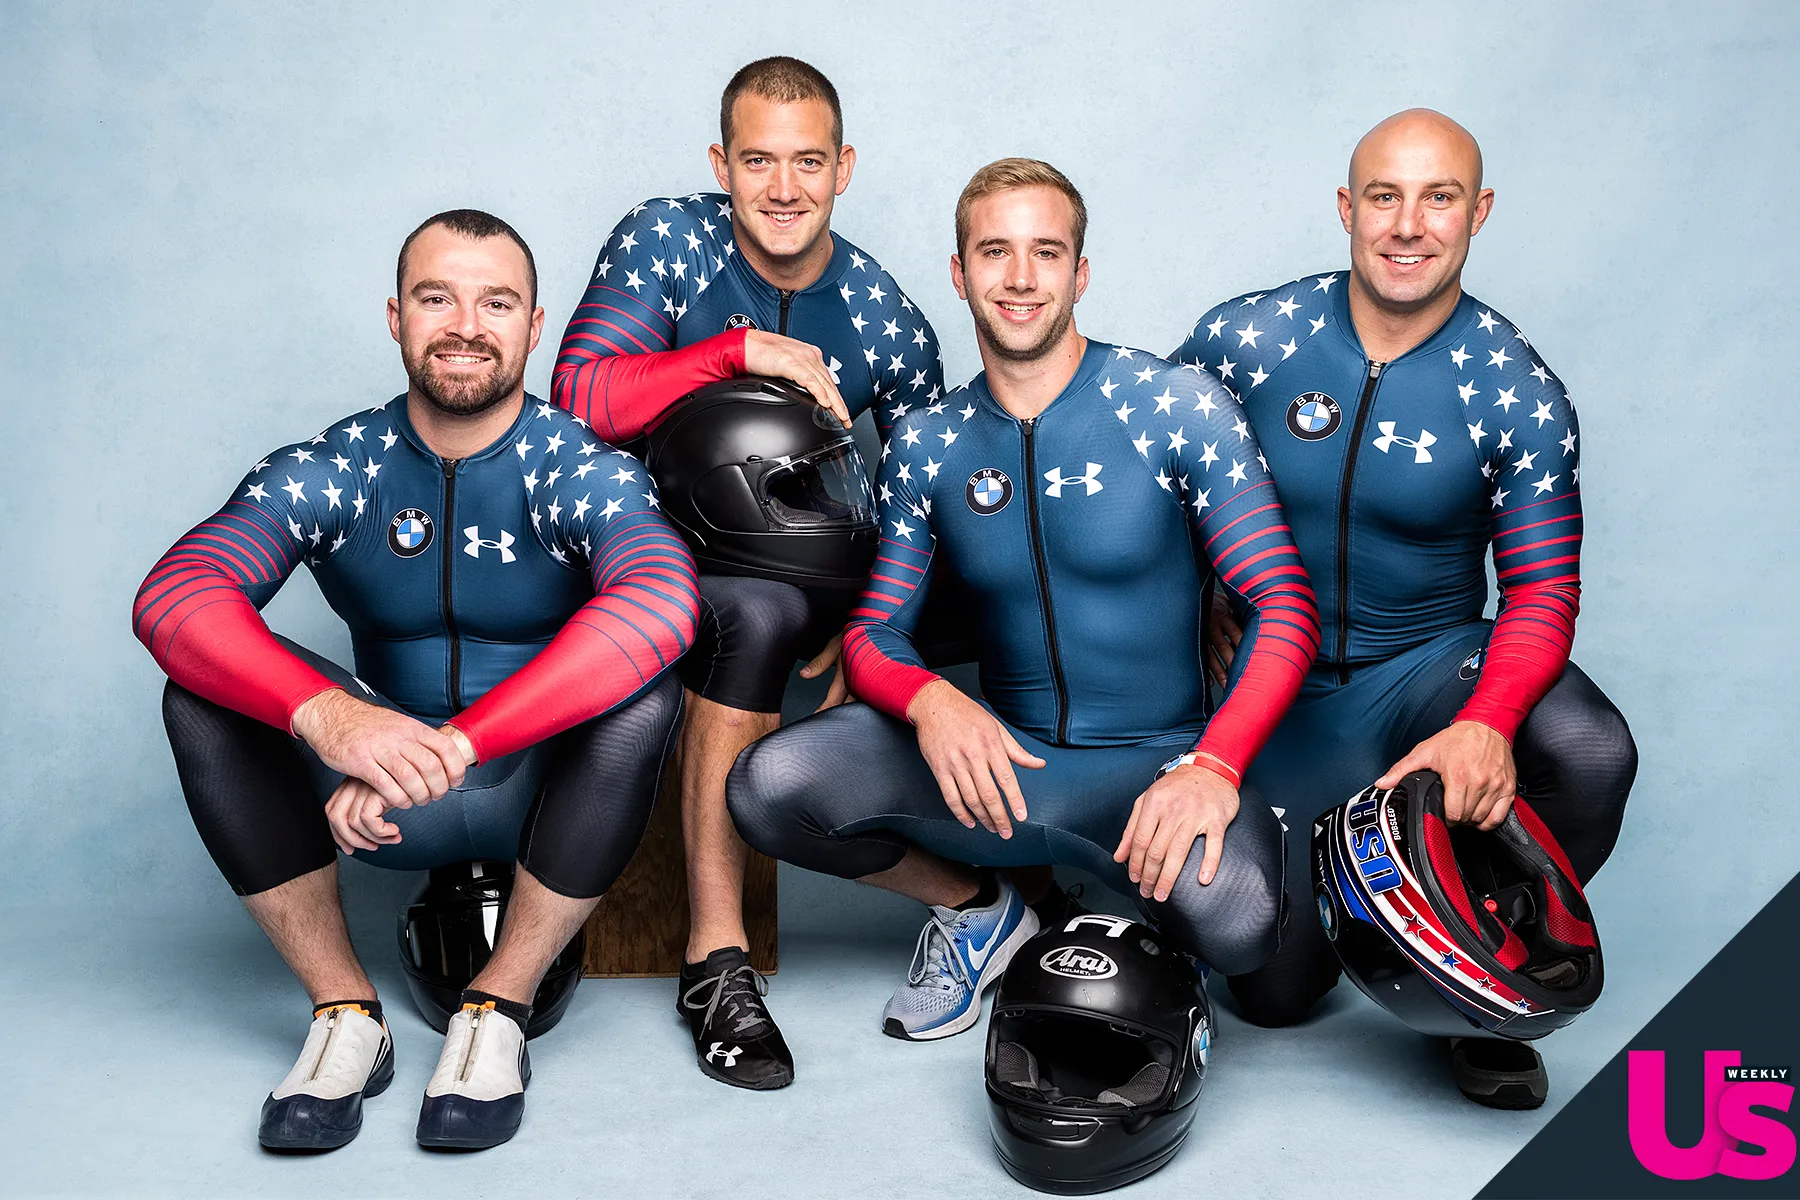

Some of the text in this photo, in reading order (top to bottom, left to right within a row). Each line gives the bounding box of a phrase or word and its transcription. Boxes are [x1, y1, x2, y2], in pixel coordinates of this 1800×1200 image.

[1295, 393, 1340, 414] BMW
[969, 469, 1008, 486] BMW
[392, 510, 431, 527] BMW
[1347, 798, 1404, 896] USA
[1043, 948, 1109, 973] Arai
